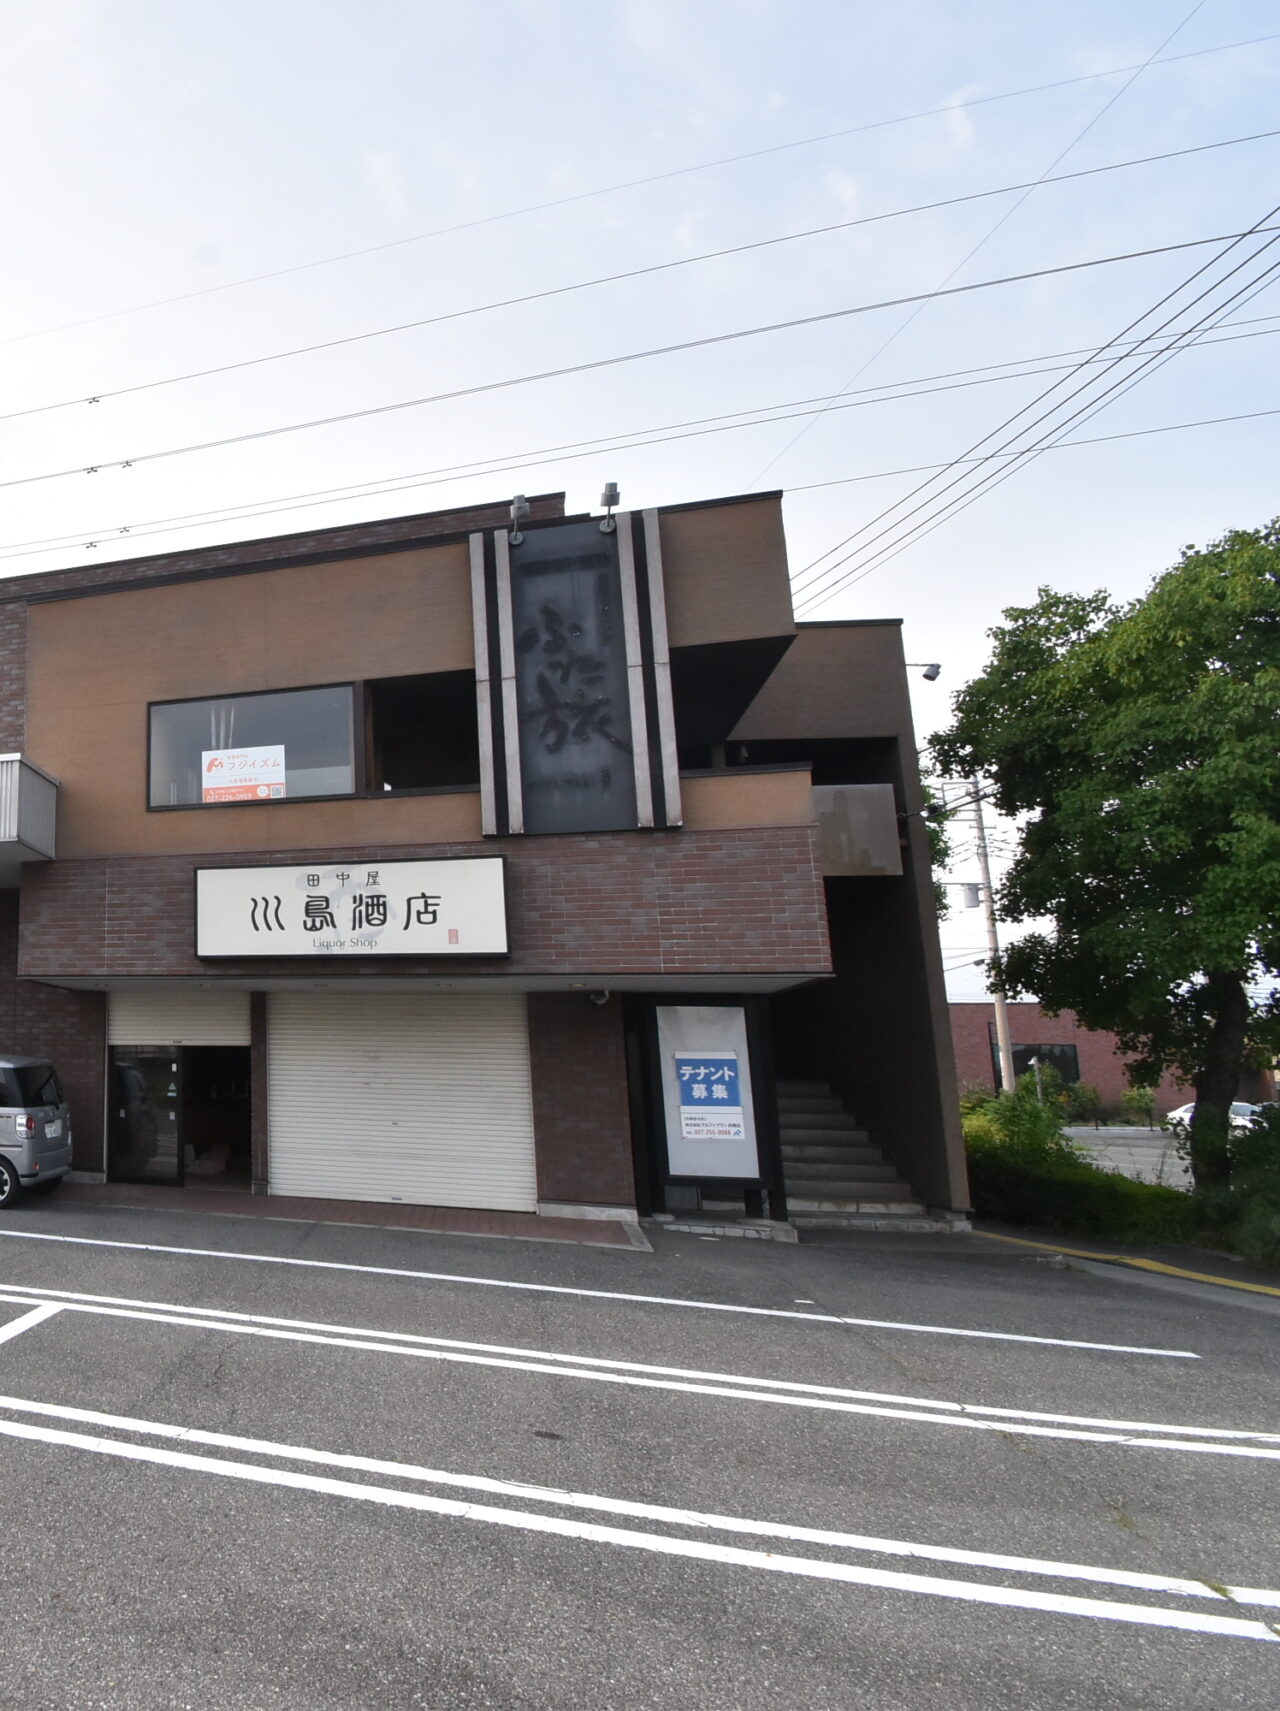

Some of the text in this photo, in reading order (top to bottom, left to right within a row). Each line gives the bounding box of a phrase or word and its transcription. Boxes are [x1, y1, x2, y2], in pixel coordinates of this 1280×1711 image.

[307, 871, 381, 887] 田中屋
[250, 892, 442, 932] 川島酒店
[313, 937, 377, 950] Liquor Shop
[680, 1066, 735, 1081] テナント
[691, 1084, 729, 1099] 募集
